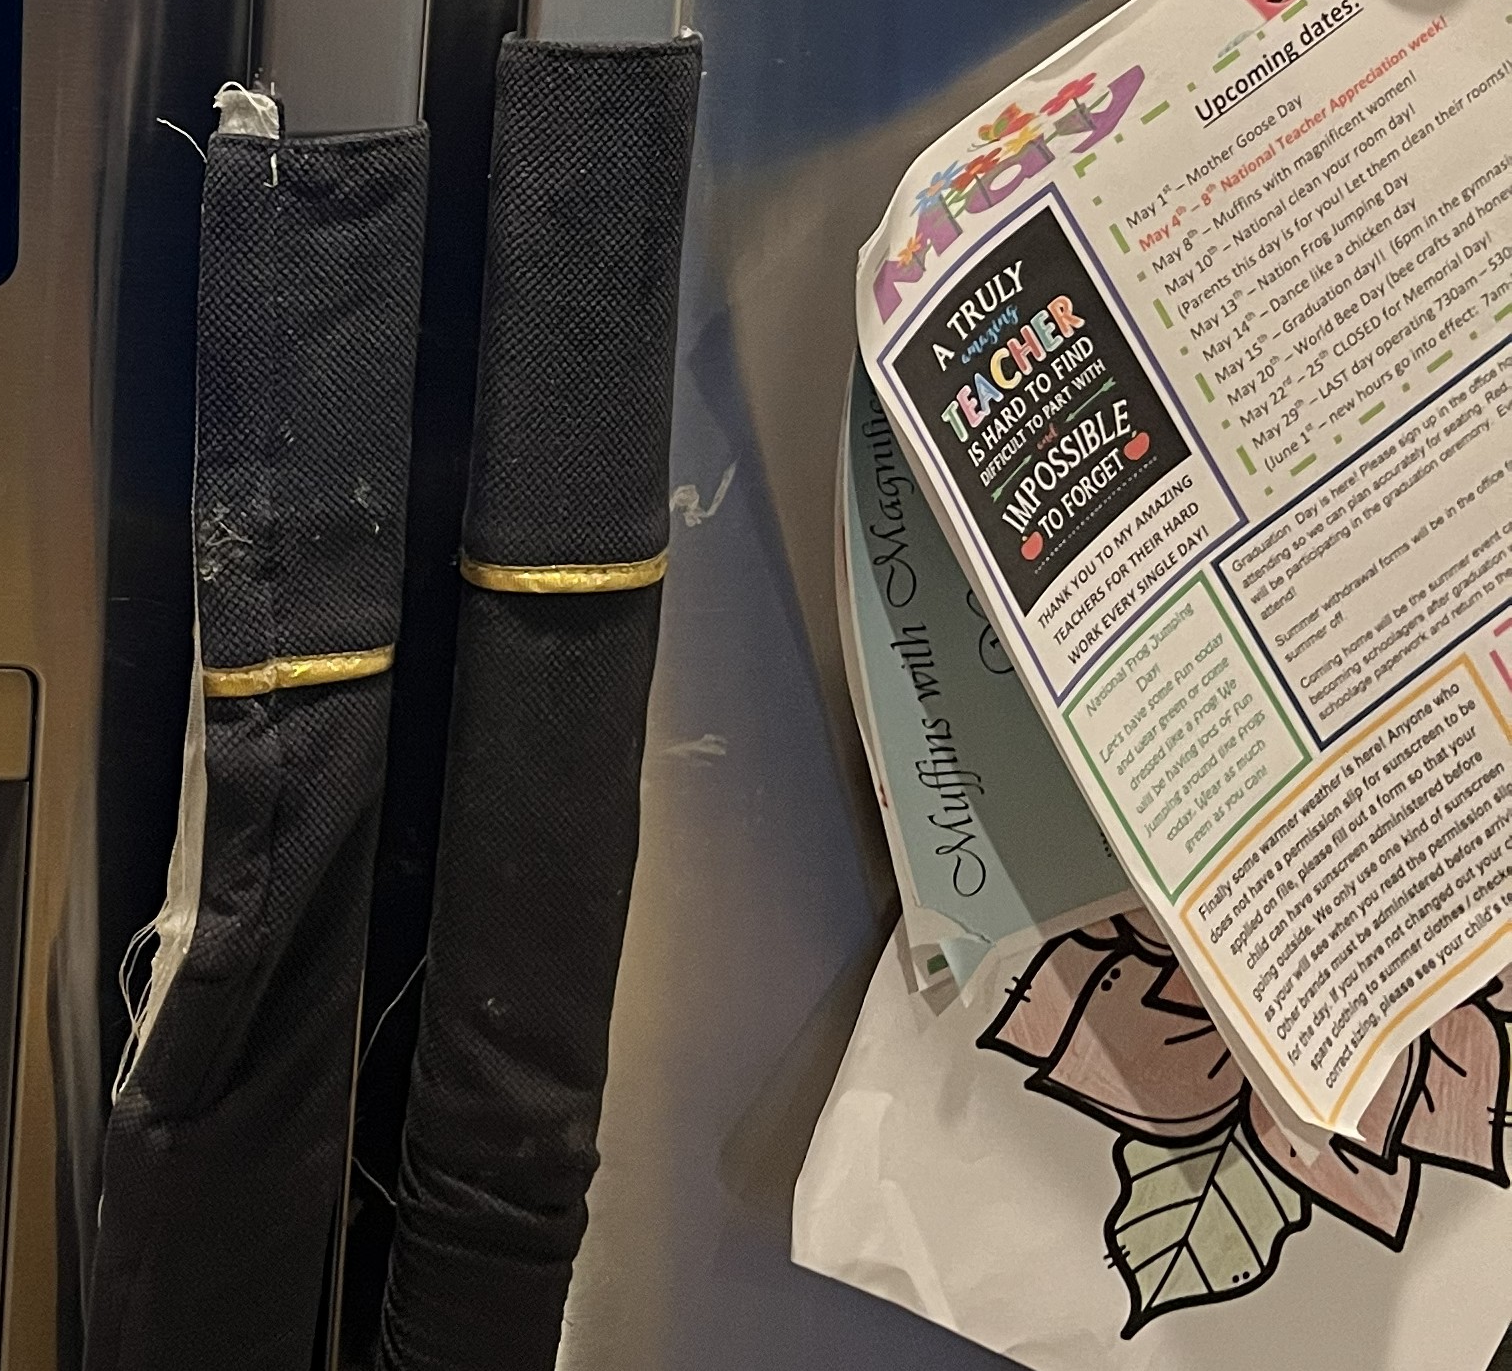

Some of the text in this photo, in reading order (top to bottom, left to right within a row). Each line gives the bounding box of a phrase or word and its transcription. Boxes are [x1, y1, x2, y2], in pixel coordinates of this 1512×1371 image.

[1138, 223, 1171, 253] May
[1219, 142, 1277, 193] National
[1274, 107, 1327, 151] Teacher
[1329, 48, 1409, 114] Appreciation
[1407, 12, 1449, 52] week!
[1193, 41, 1300, 124] Upcoming
[932, 260, 1023, 372] A TRULY
[941, 295, 1086, 443] TEACHER
[961, 305, 1019, 364] amazing
[967, 335, 1094, 468] IS HARD TO FIND
[979, 359, 1107, 487] DIFFICULT TO PART WITH
[1001, 399, 1133, 534] IMPOSSIBLE
[1036, 422, 1059, 451] and
[1037, 474, 1194, 630] THANK YOU TO MY AMAZING
[1038, 447, 1126, 539] TO FORGET
[890, 620, 941, 704] with
[915, 717, 986, 898] Muffins
[1198, 683, 1460, 922] Finally some warmer weather is here! Anyone who
